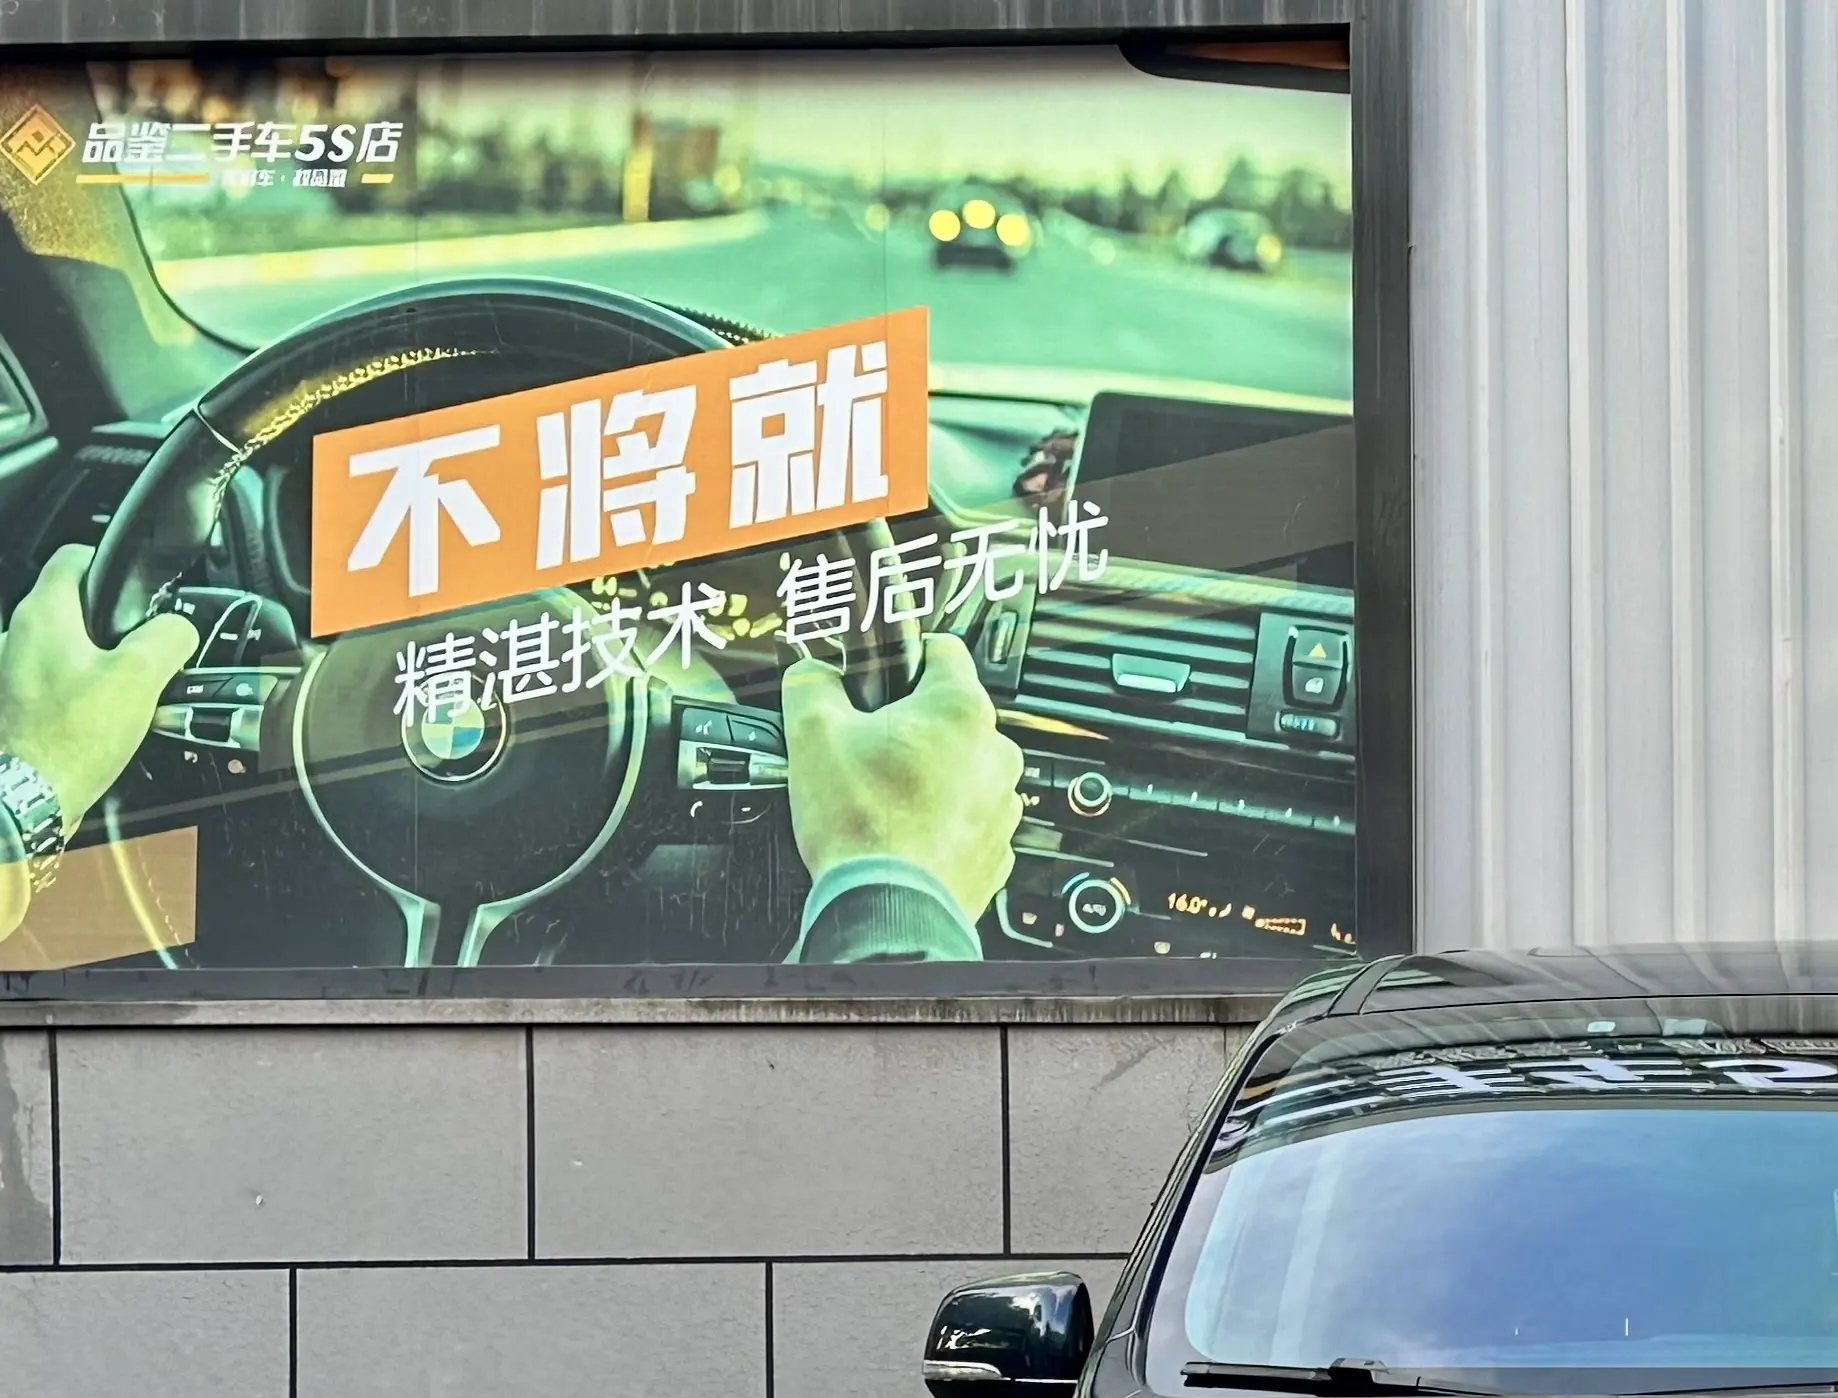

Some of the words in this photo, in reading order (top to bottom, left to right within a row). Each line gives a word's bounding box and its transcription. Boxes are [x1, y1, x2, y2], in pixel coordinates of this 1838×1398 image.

[81, 120, 404, 163] 品鉴二手车5S店
[346, 340, 890, 598] 不将就
[392, 581, 729, 729] 精湛技术
[776, 498, 1111, 647] 售后无忧
